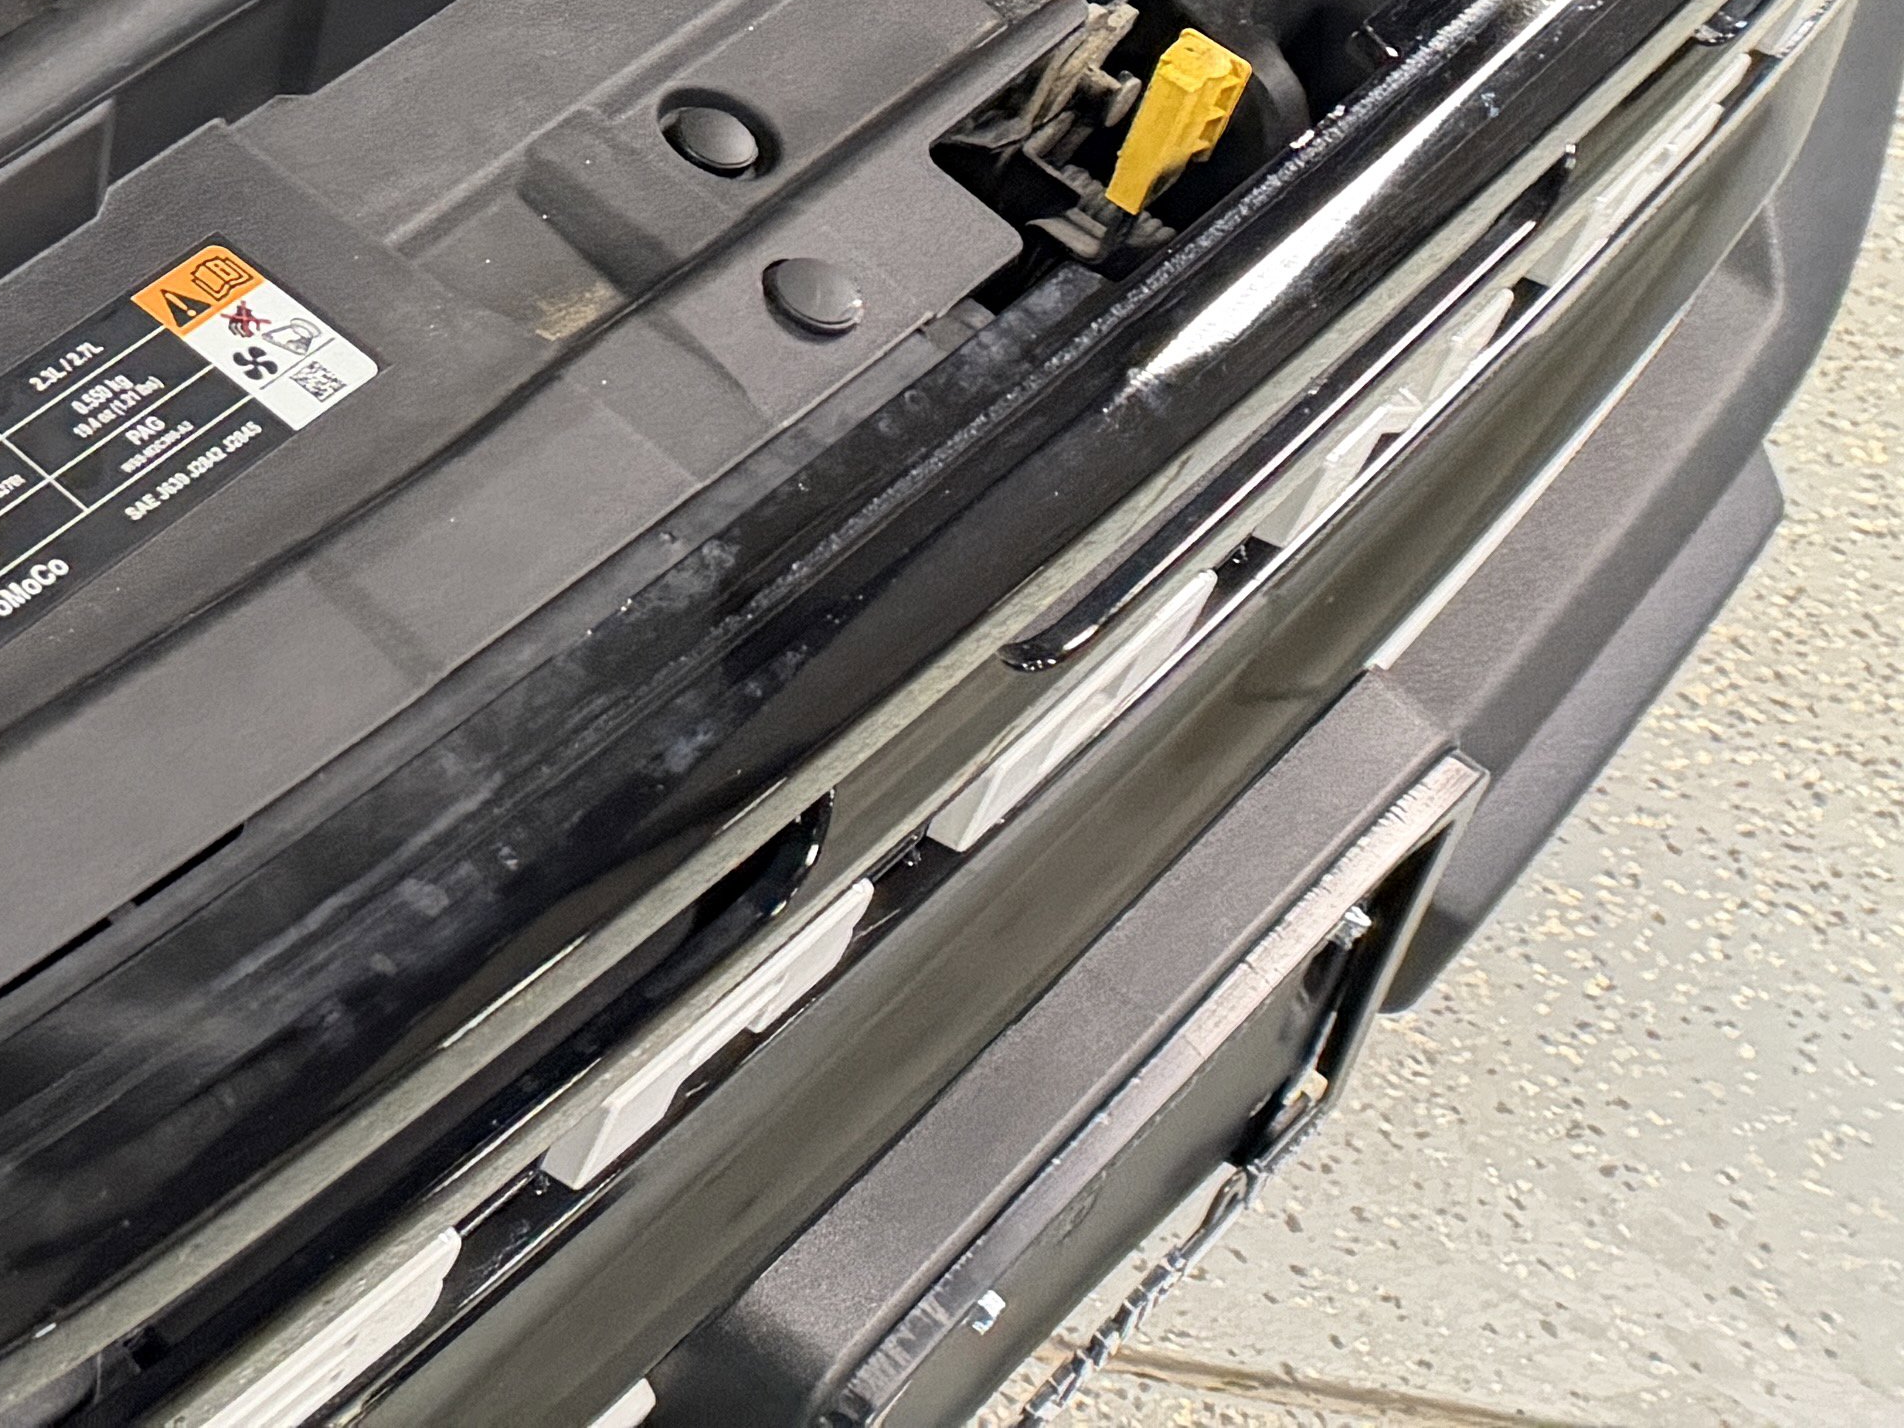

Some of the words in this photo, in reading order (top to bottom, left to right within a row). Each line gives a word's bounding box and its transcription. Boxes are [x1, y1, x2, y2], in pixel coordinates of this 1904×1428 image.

[66, 342, 104, 367] 2.7L
[104, 374, 134, 393] kg
[125, 416, 166, 445] PAG
[124, 494, 161, 521] SAE
